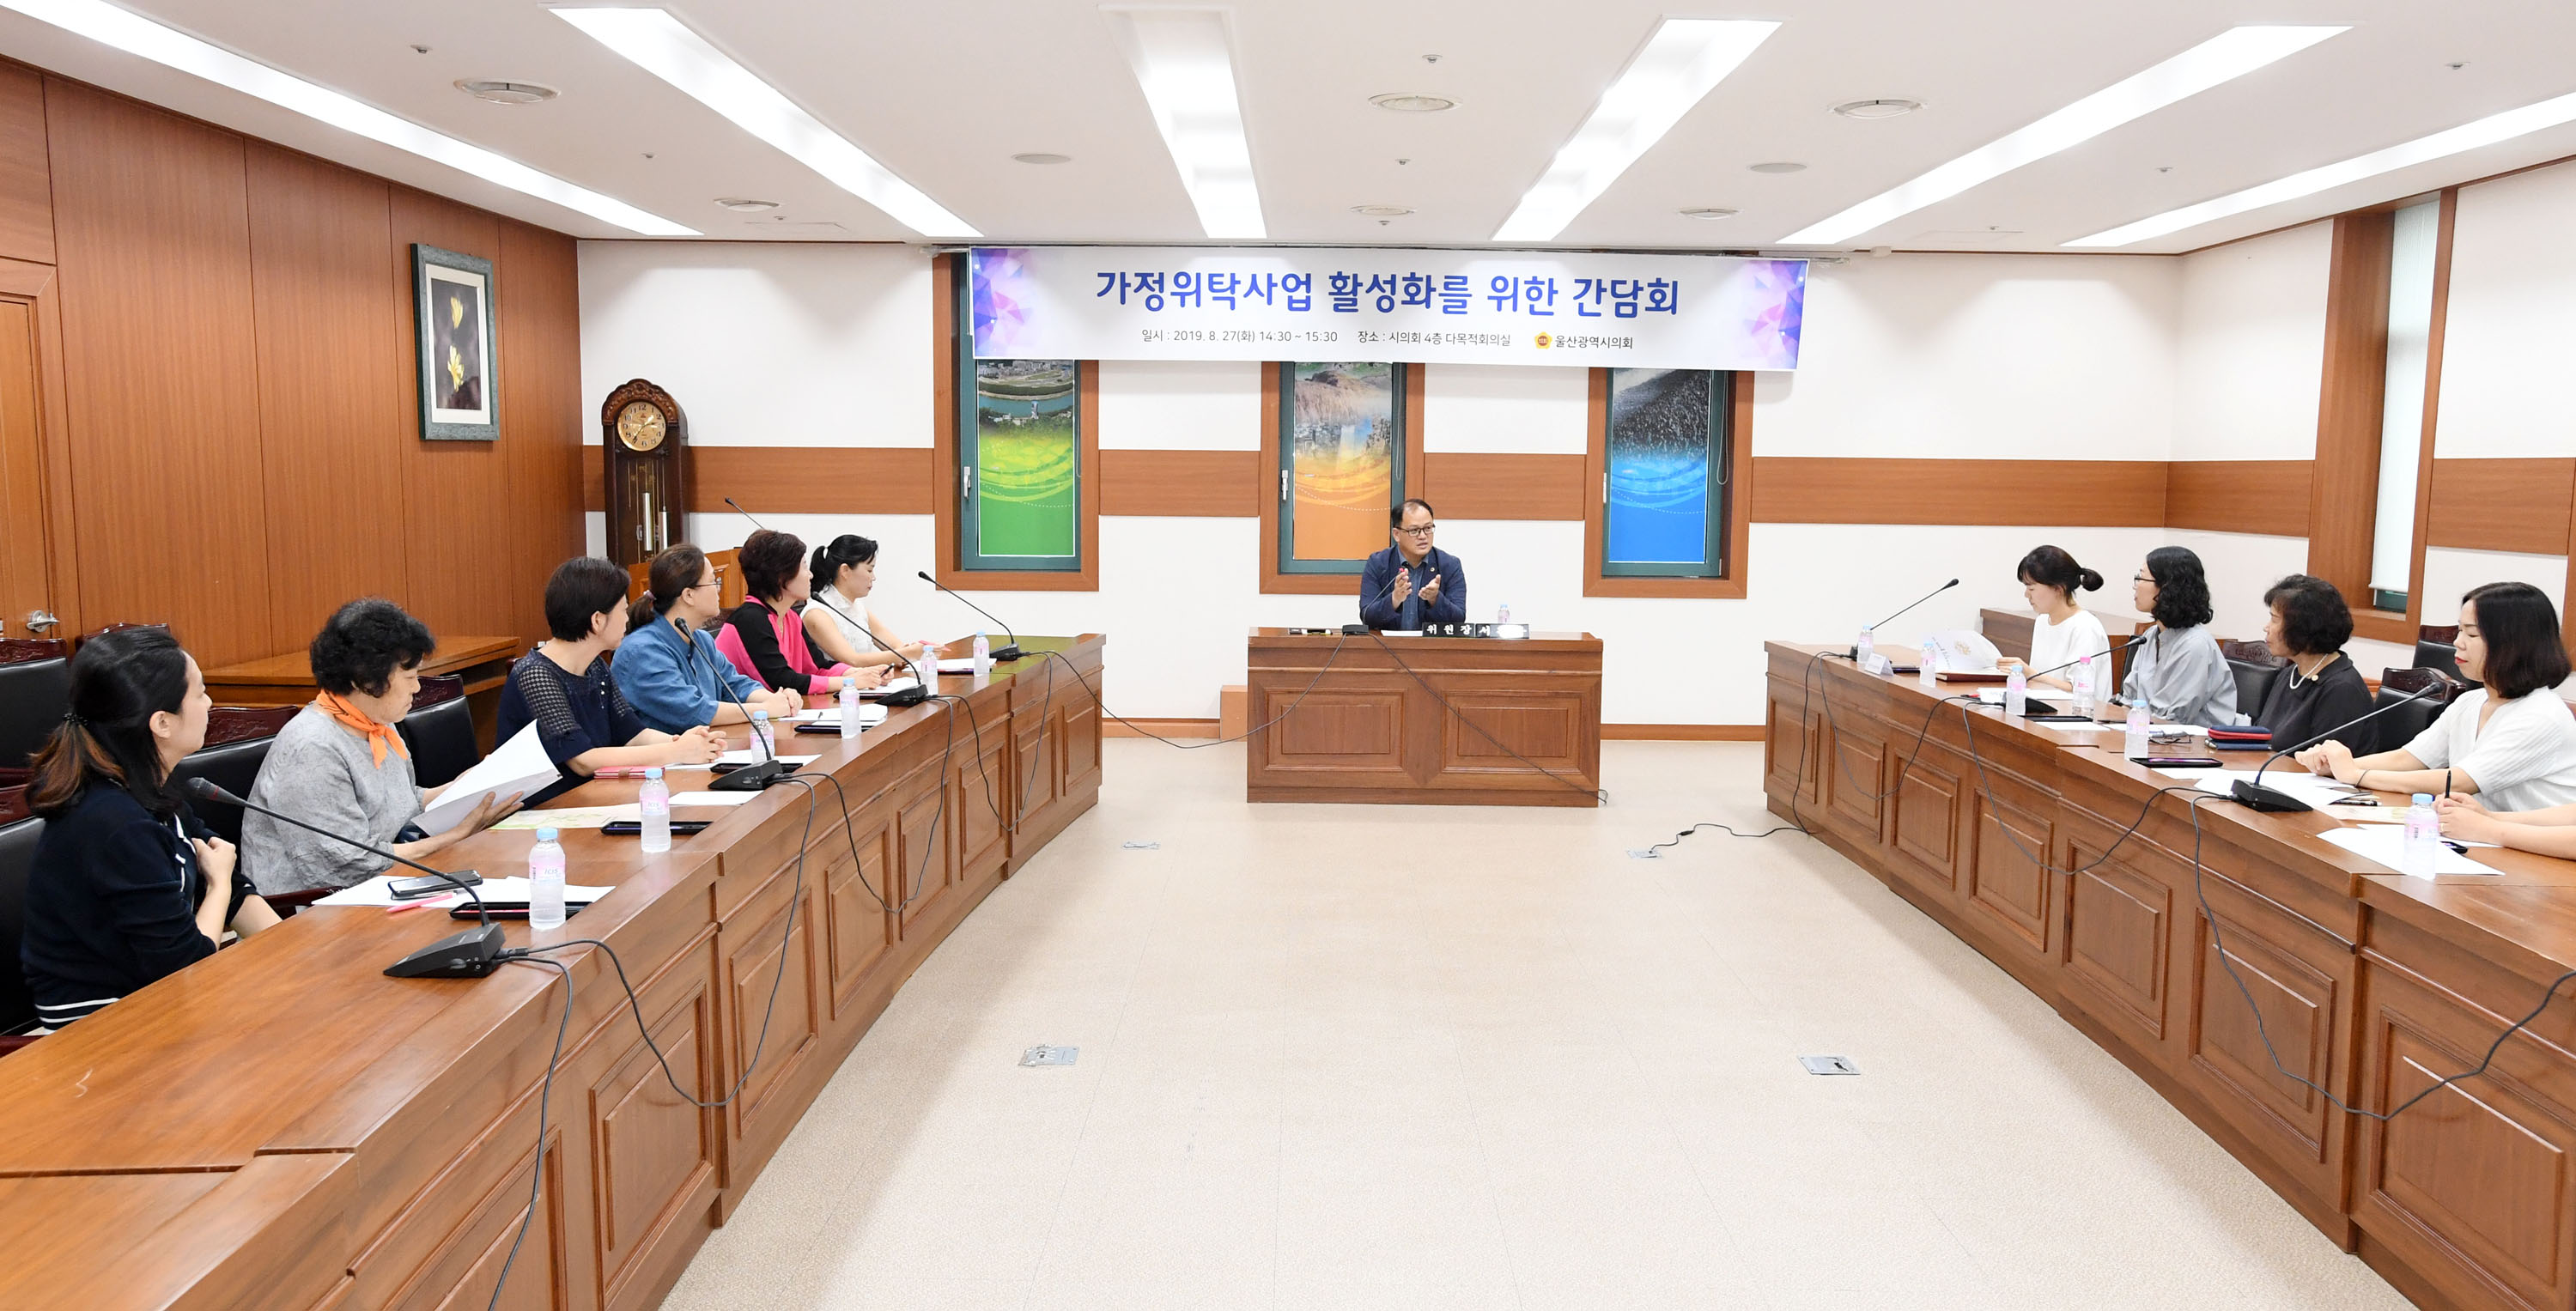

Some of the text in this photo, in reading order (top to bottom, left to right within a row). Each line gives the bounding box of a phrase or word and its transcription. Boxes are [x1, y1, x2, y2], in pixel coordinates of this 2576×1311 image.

[1097, 270, 1679, 319] 가정위탁사업 활성화를 위한 간담회
[1141, 329, 1163, 343] 일시
[1174, 331, 1206, 342] 2019.
[1208, 331, 1218, 342] 8.
[1222, 330, 1255, 343] 27(화)
[1260, 331, 1291, 342] 14:30
[1305, 331, 1338, 343] 15:30
[1358, 331, 1379, 343] 장소
[1388, 331, 1421, 344] 시의회
[1424, 332, 1443, 345] 4층
[1445, 332, 1510, 347] 다목적회의실
[1555, 335, 1633, 349] 울산광역시의회
[1426, 623, 1472, 634] 위원장
